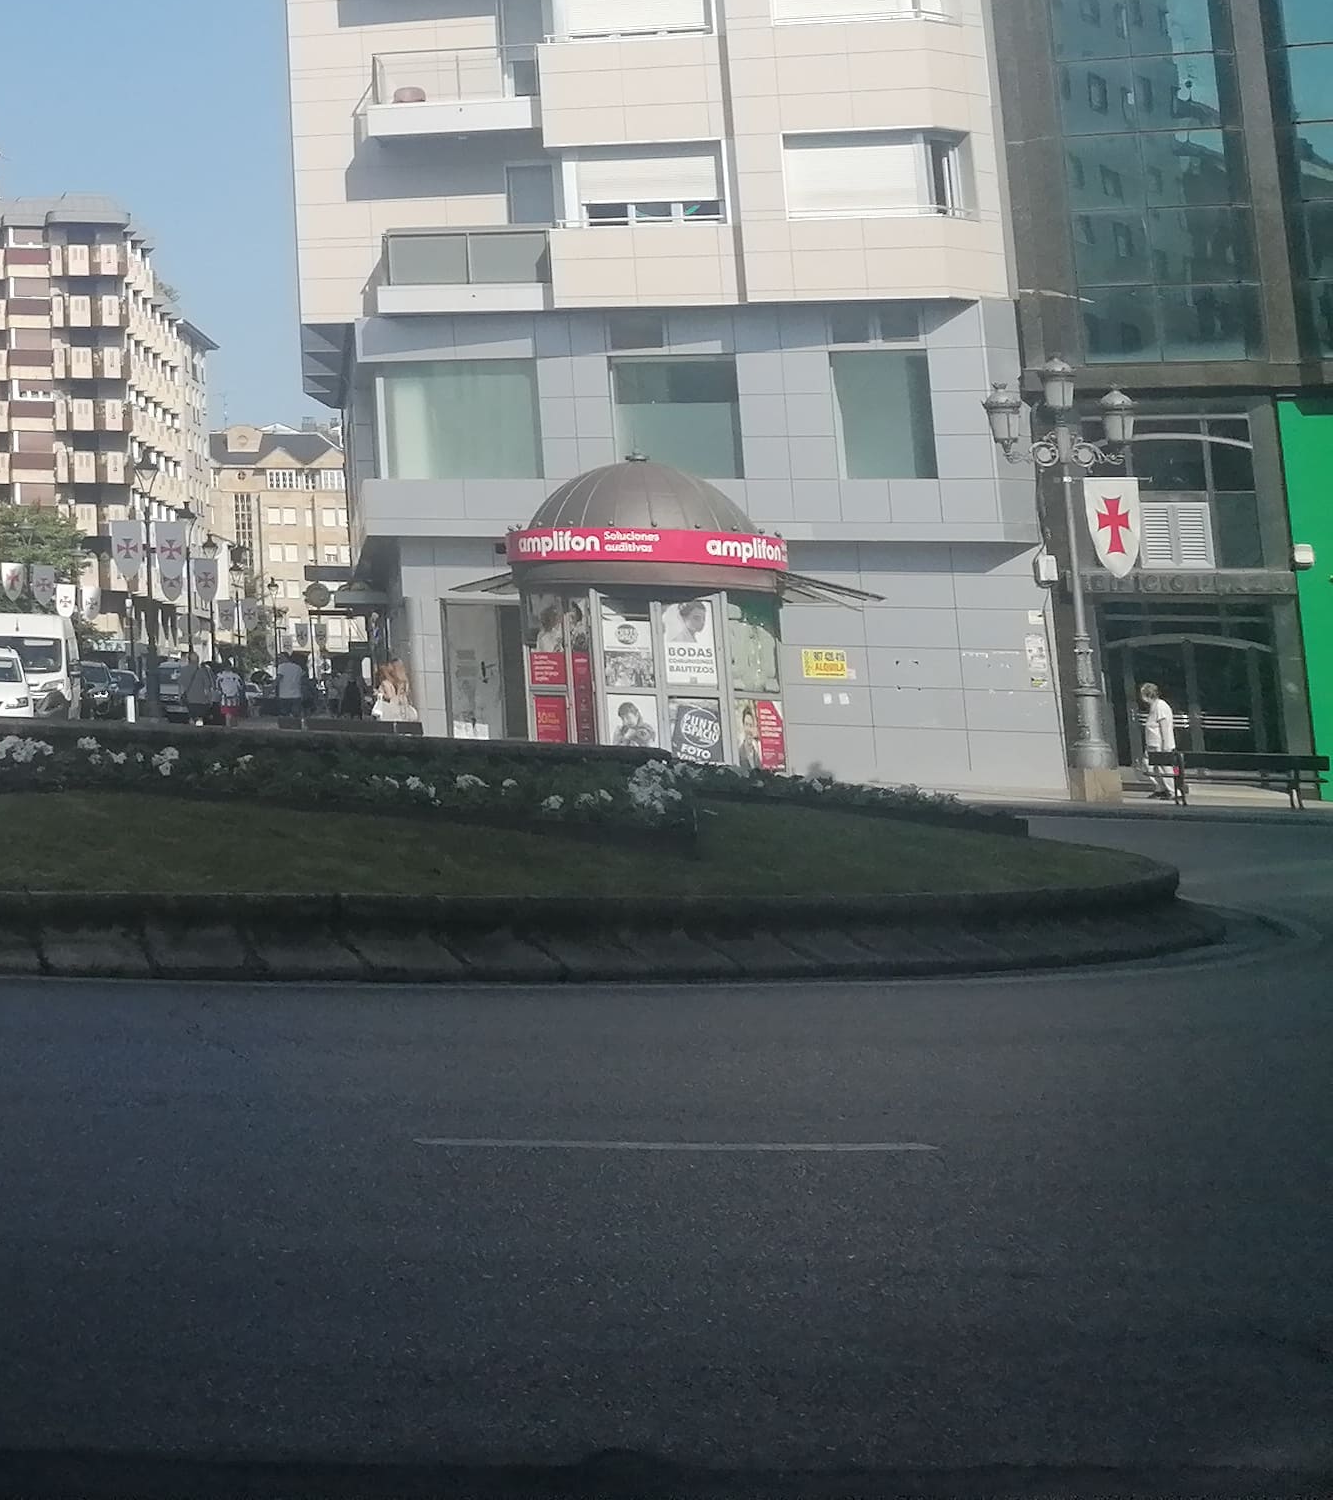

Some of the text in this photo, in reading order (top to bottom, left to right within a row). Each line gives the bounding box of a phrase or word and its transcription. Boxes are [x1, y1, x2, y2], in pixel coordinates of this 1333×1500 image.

[518, 530, 660, 557] amplifon Soluciones
[604, 542, 654, 553] auditivas
[706, 537, 782, 563] amplifon
[668, 647, 713, 658] BODAS
[669, 665, 715, 674] BAUTIZOS
[684, 713, 720, 732] PUNTO
[682, 721, 720, 744] ESPACIO
[681, 743, 712, 759] FOTO
